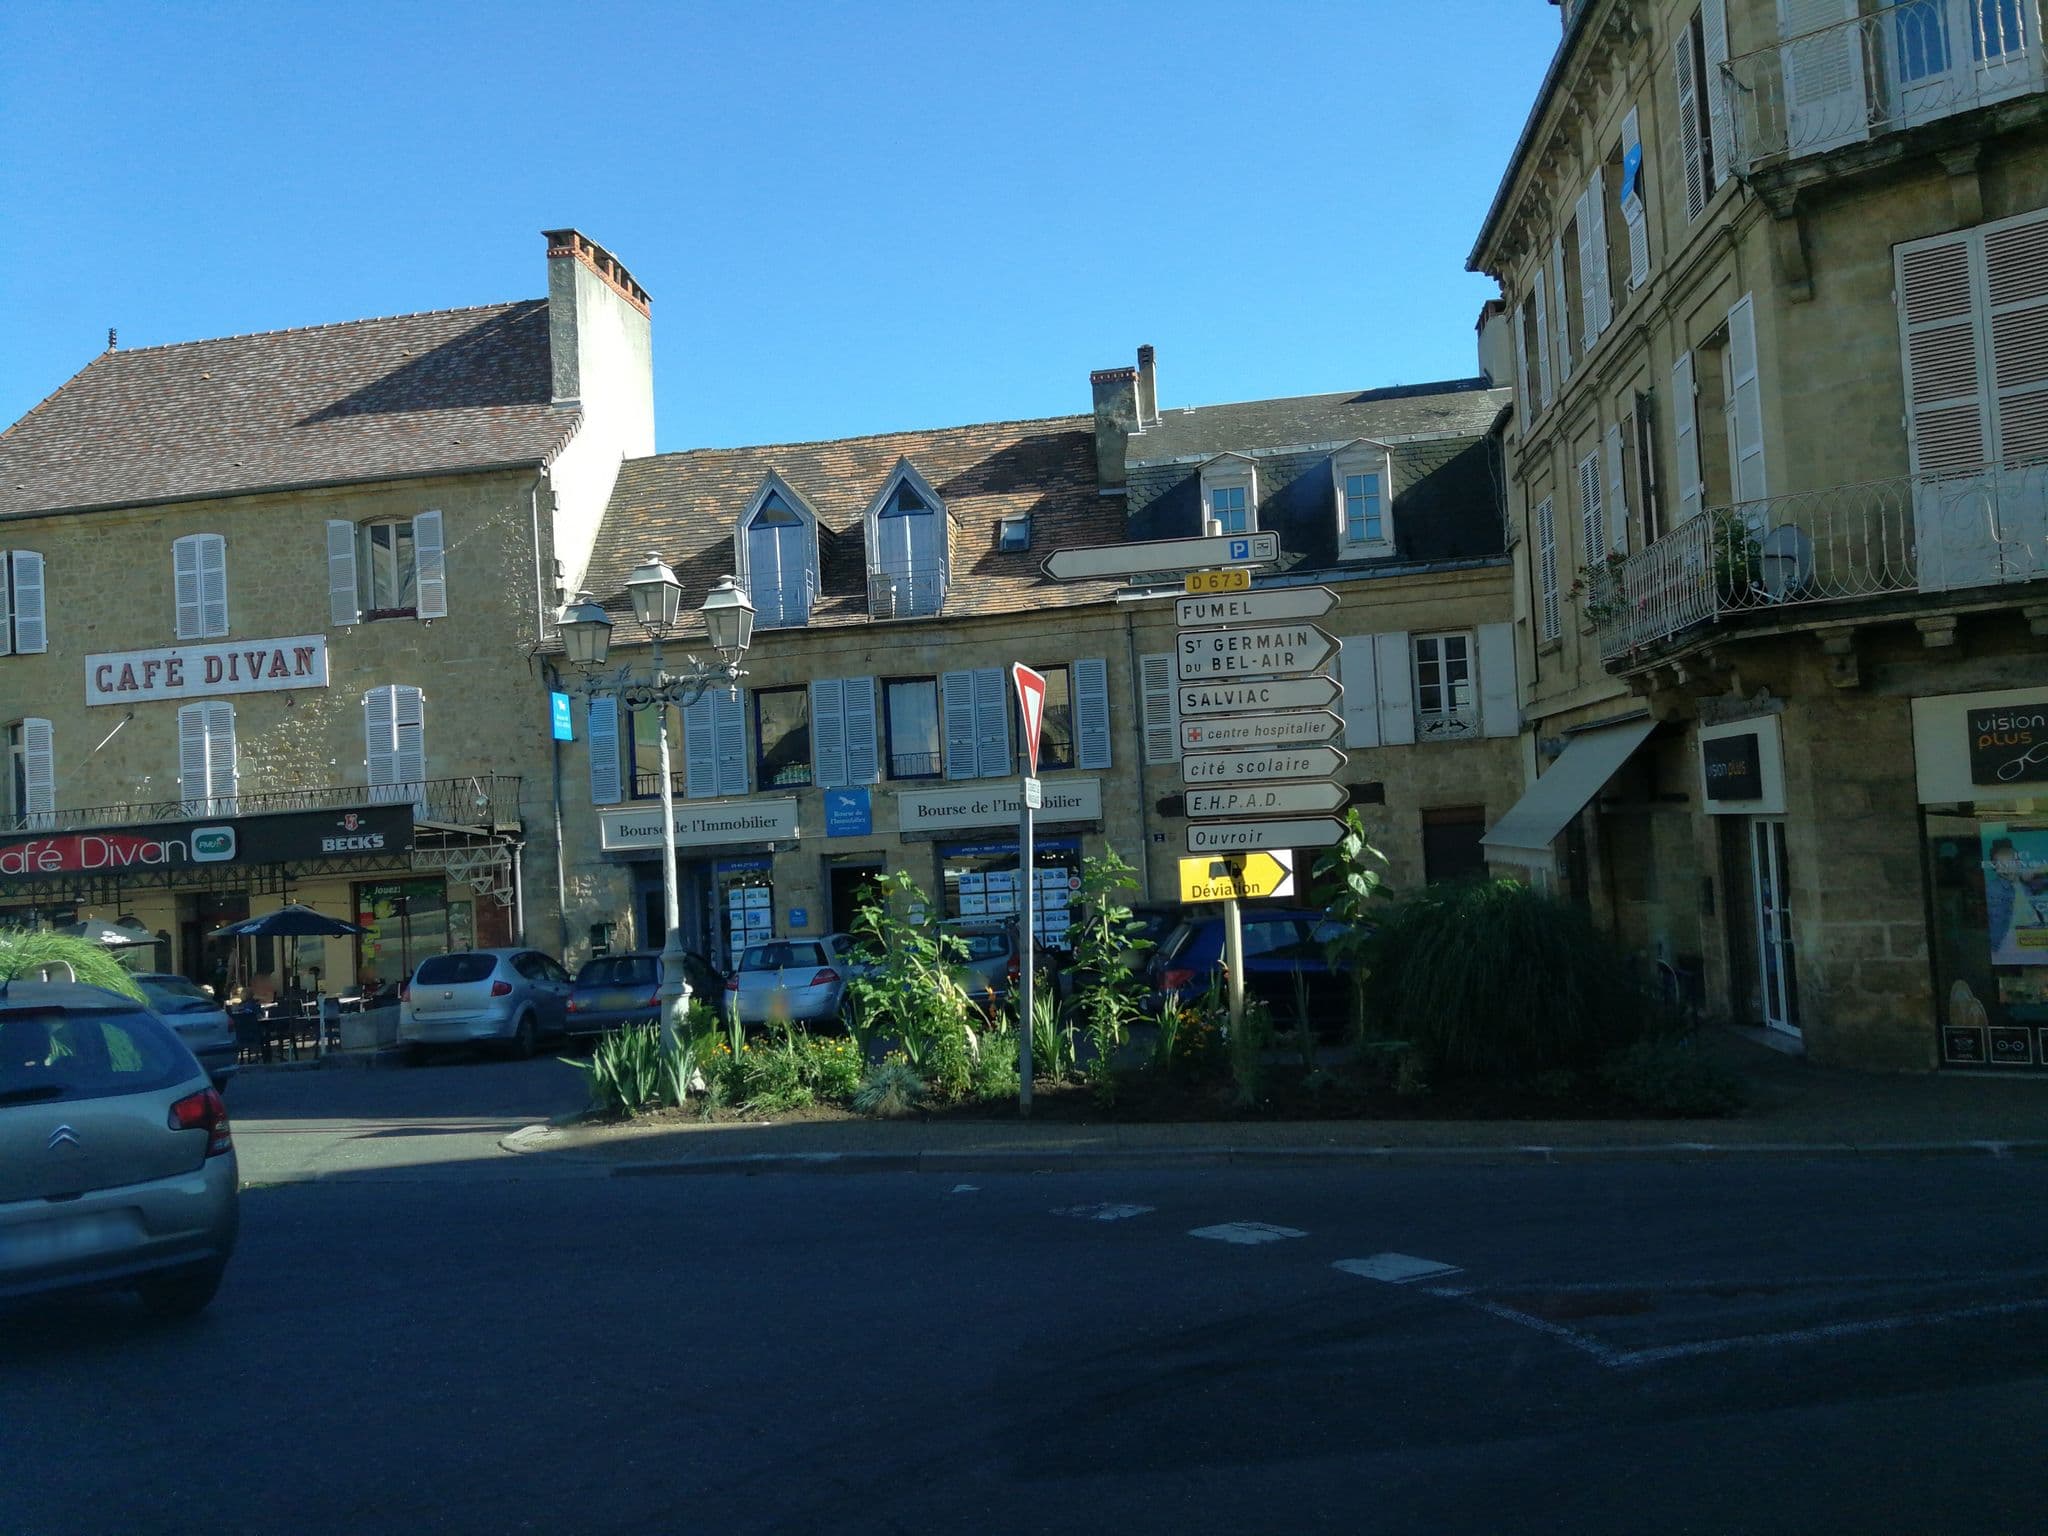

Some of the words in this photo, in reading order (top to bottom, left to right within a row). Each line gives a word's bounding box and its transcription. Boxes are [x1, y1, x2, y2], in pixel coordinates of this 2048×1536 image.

[1192, 576, 1201, 590] D
[1209, 573, 1243, 588] 673
[1183, 601, 1252, 620] FUMEL
[1214, 631, 1308, 651] GERMAIN
[95, 650, 184, 693] CAFÉ
[204, 646, 316, 684] DIVAN
[1185, 663, 1201, 673] DU
[1212, 652, 1294, 671] BEL-AIR
[1187, 688, 1270, 708] SALVIAC
[1208, 725, 1249, 740] centre
[1255, 721, 1326, 740] hospitalier
[1977, 712, 2045, 732] vision
[1978, 731, 2033, 750] plus
[1191, 761, 1225, 776] cité
[1236, 756, 1310, 774] scolaire
[917, 804, 967, 818] Bourse
[971, 800, 989, 814] de
[993, 795, 1082, 812] l'Imbilier
[1194, 792, 1282, 811] E.H.P.A.D.
[692, 816, 778, 833] l'Immobilier
[321, 833, 385, 851] BECK'S
[1195, 829, 1263, 846] Ouvroir
[80, 836, 187, 869] Divan
[1192, 881, 1260, 898] Déviation
